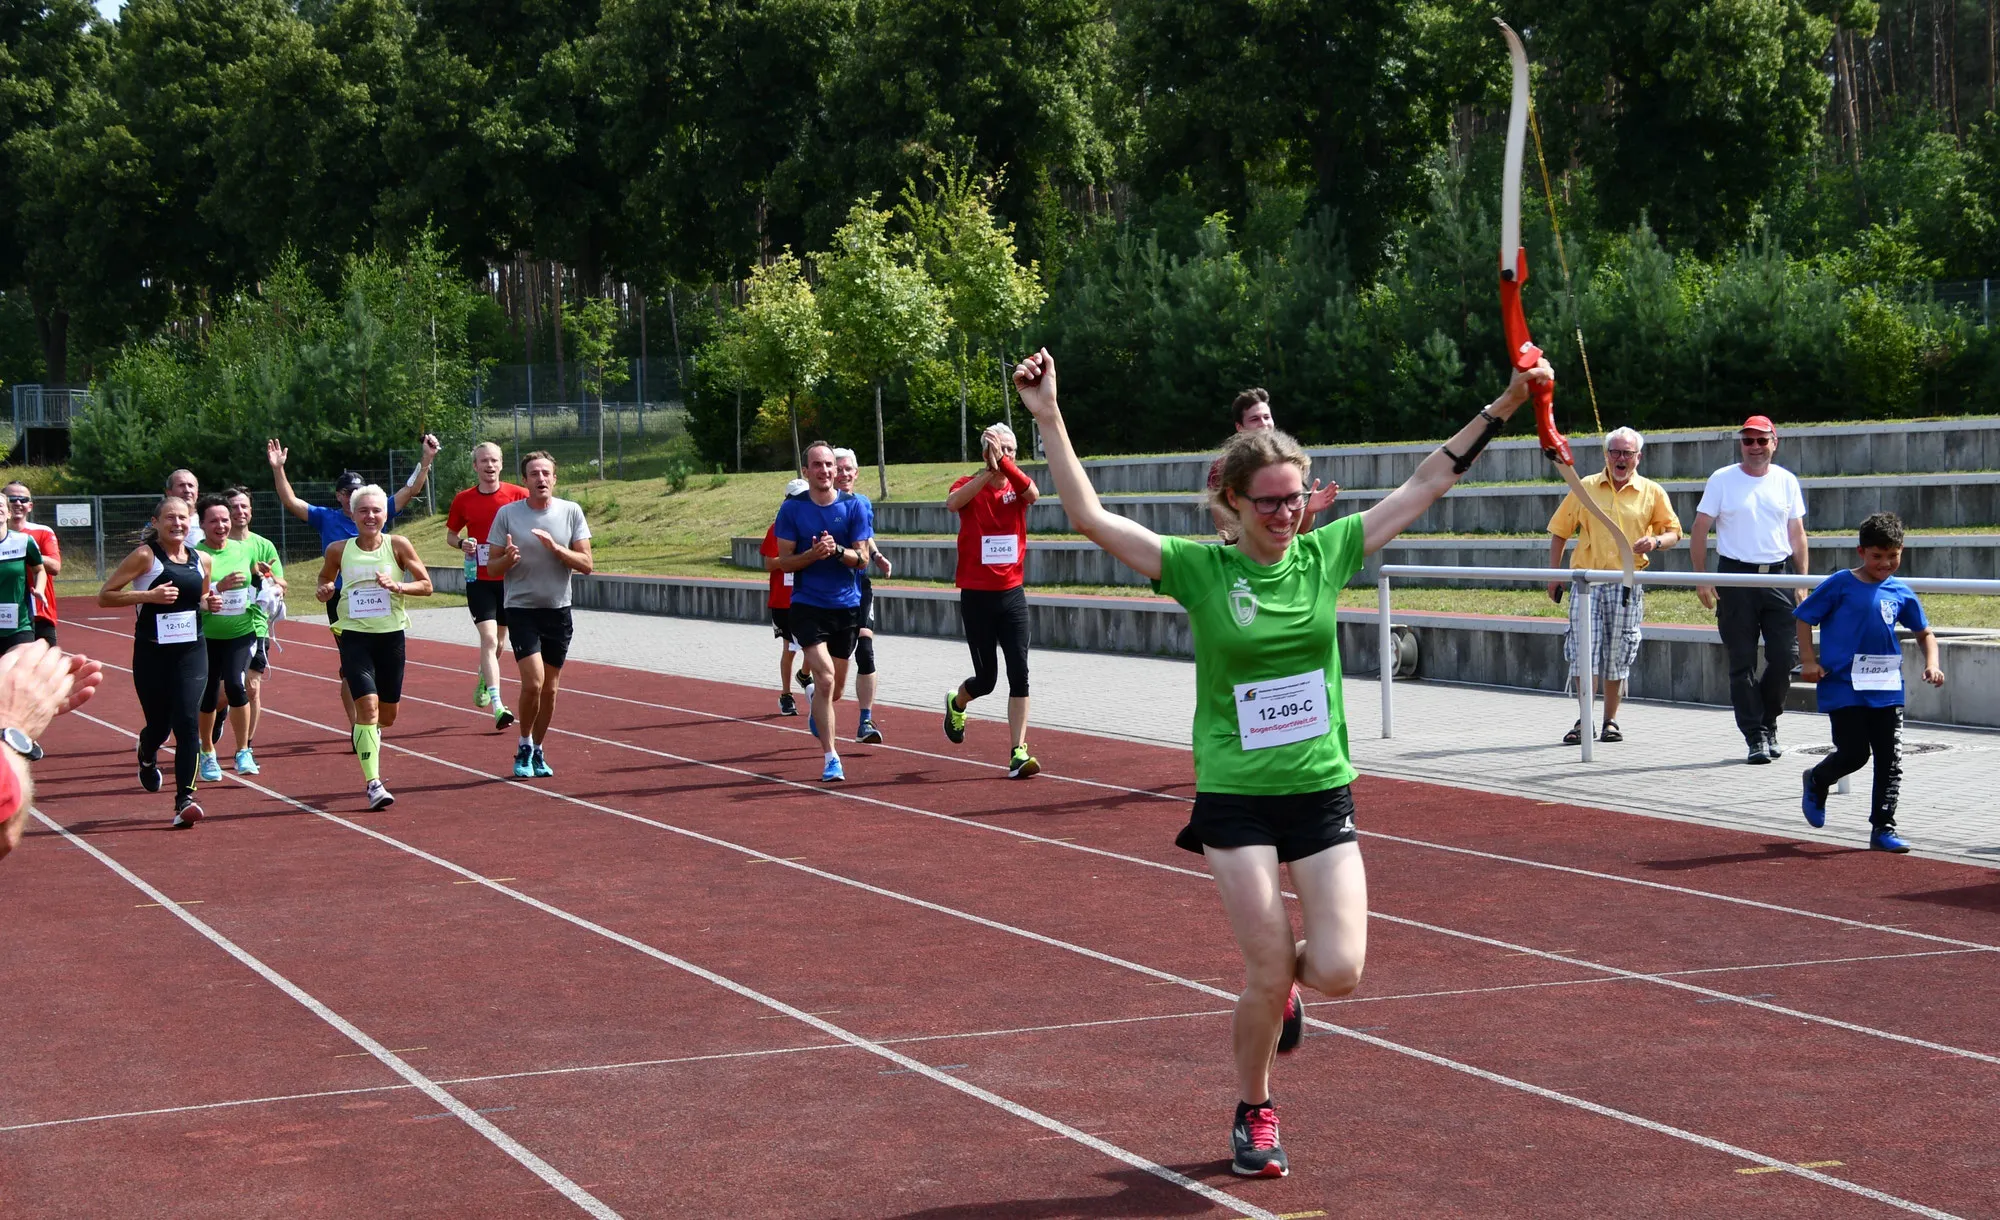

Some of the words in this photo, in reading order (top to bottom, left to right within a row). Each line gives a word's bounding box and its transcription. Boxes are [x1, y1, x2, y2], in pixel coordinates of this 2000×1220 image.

[166, 622, 191, 630] 12-10-C
[1258, 699, 1314, 721] 12-09-C
[1249, 716, 1318, 734] BogenSportWelt.de
